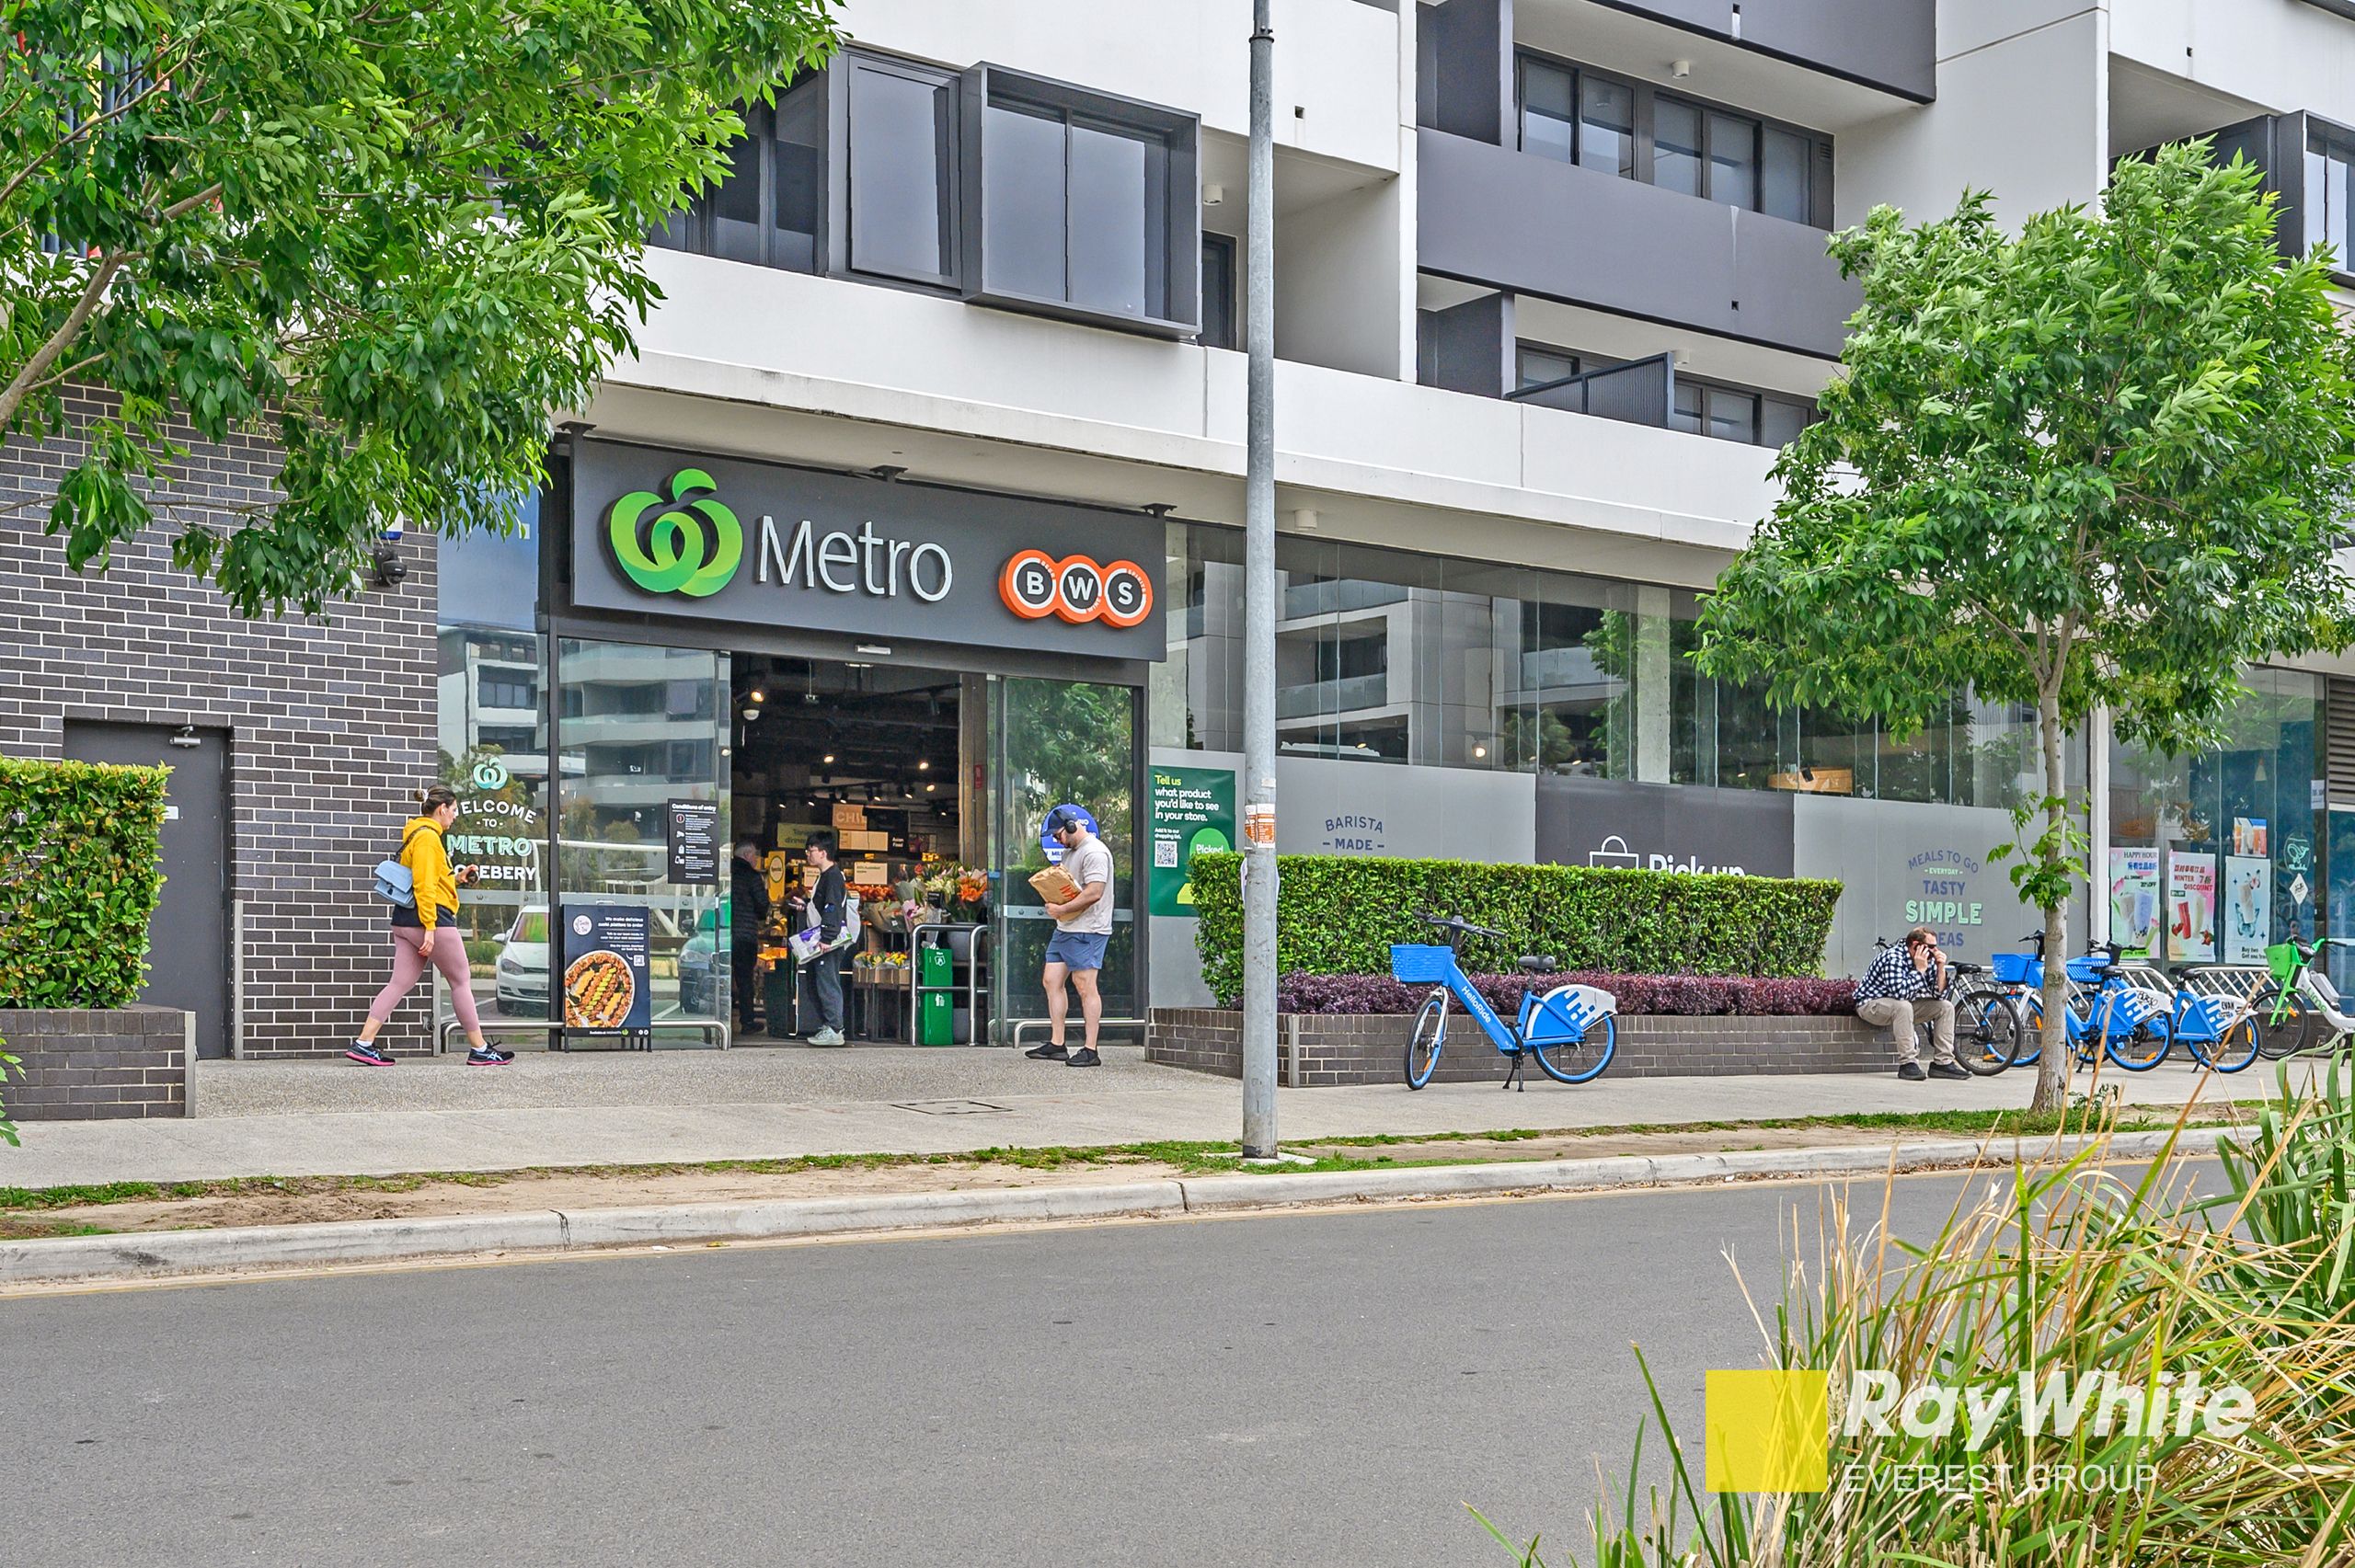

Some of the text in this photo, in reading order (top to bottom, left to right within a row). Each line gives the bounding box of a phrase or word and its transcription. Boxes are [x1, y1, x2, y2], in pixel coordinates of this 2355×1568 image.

[758, 515, 954, 602] Metro
[1155, 775, 1170, 784] Tell
[1155, 786, 1212, 799] what product
[1155, 798, 1220, 811] you'd like to see
[1155, 809, 1209, 822] in your store.
[482, 818, 498, 828] TO
[1325, 816, 1384, 834] BARISTA
[446, 834, 533, 857] METRO
[1196, 843, 1223, 854] Picked
[1335, 838, 1373, 851] MADE
[1908, 850, 1979, 874] MEALS TO GO
[1929, 867, 1959, 876] EVERYDAY
[1923, 880, 1966, 896] TASTY
[2183, 883, 2213, 891] DISCOUNT
[1905, 899, 1983, 926] SIMPLE
[1936, 932, 1965, 947] EAS
[1461, 985, 1491, 1024] HelloRide
